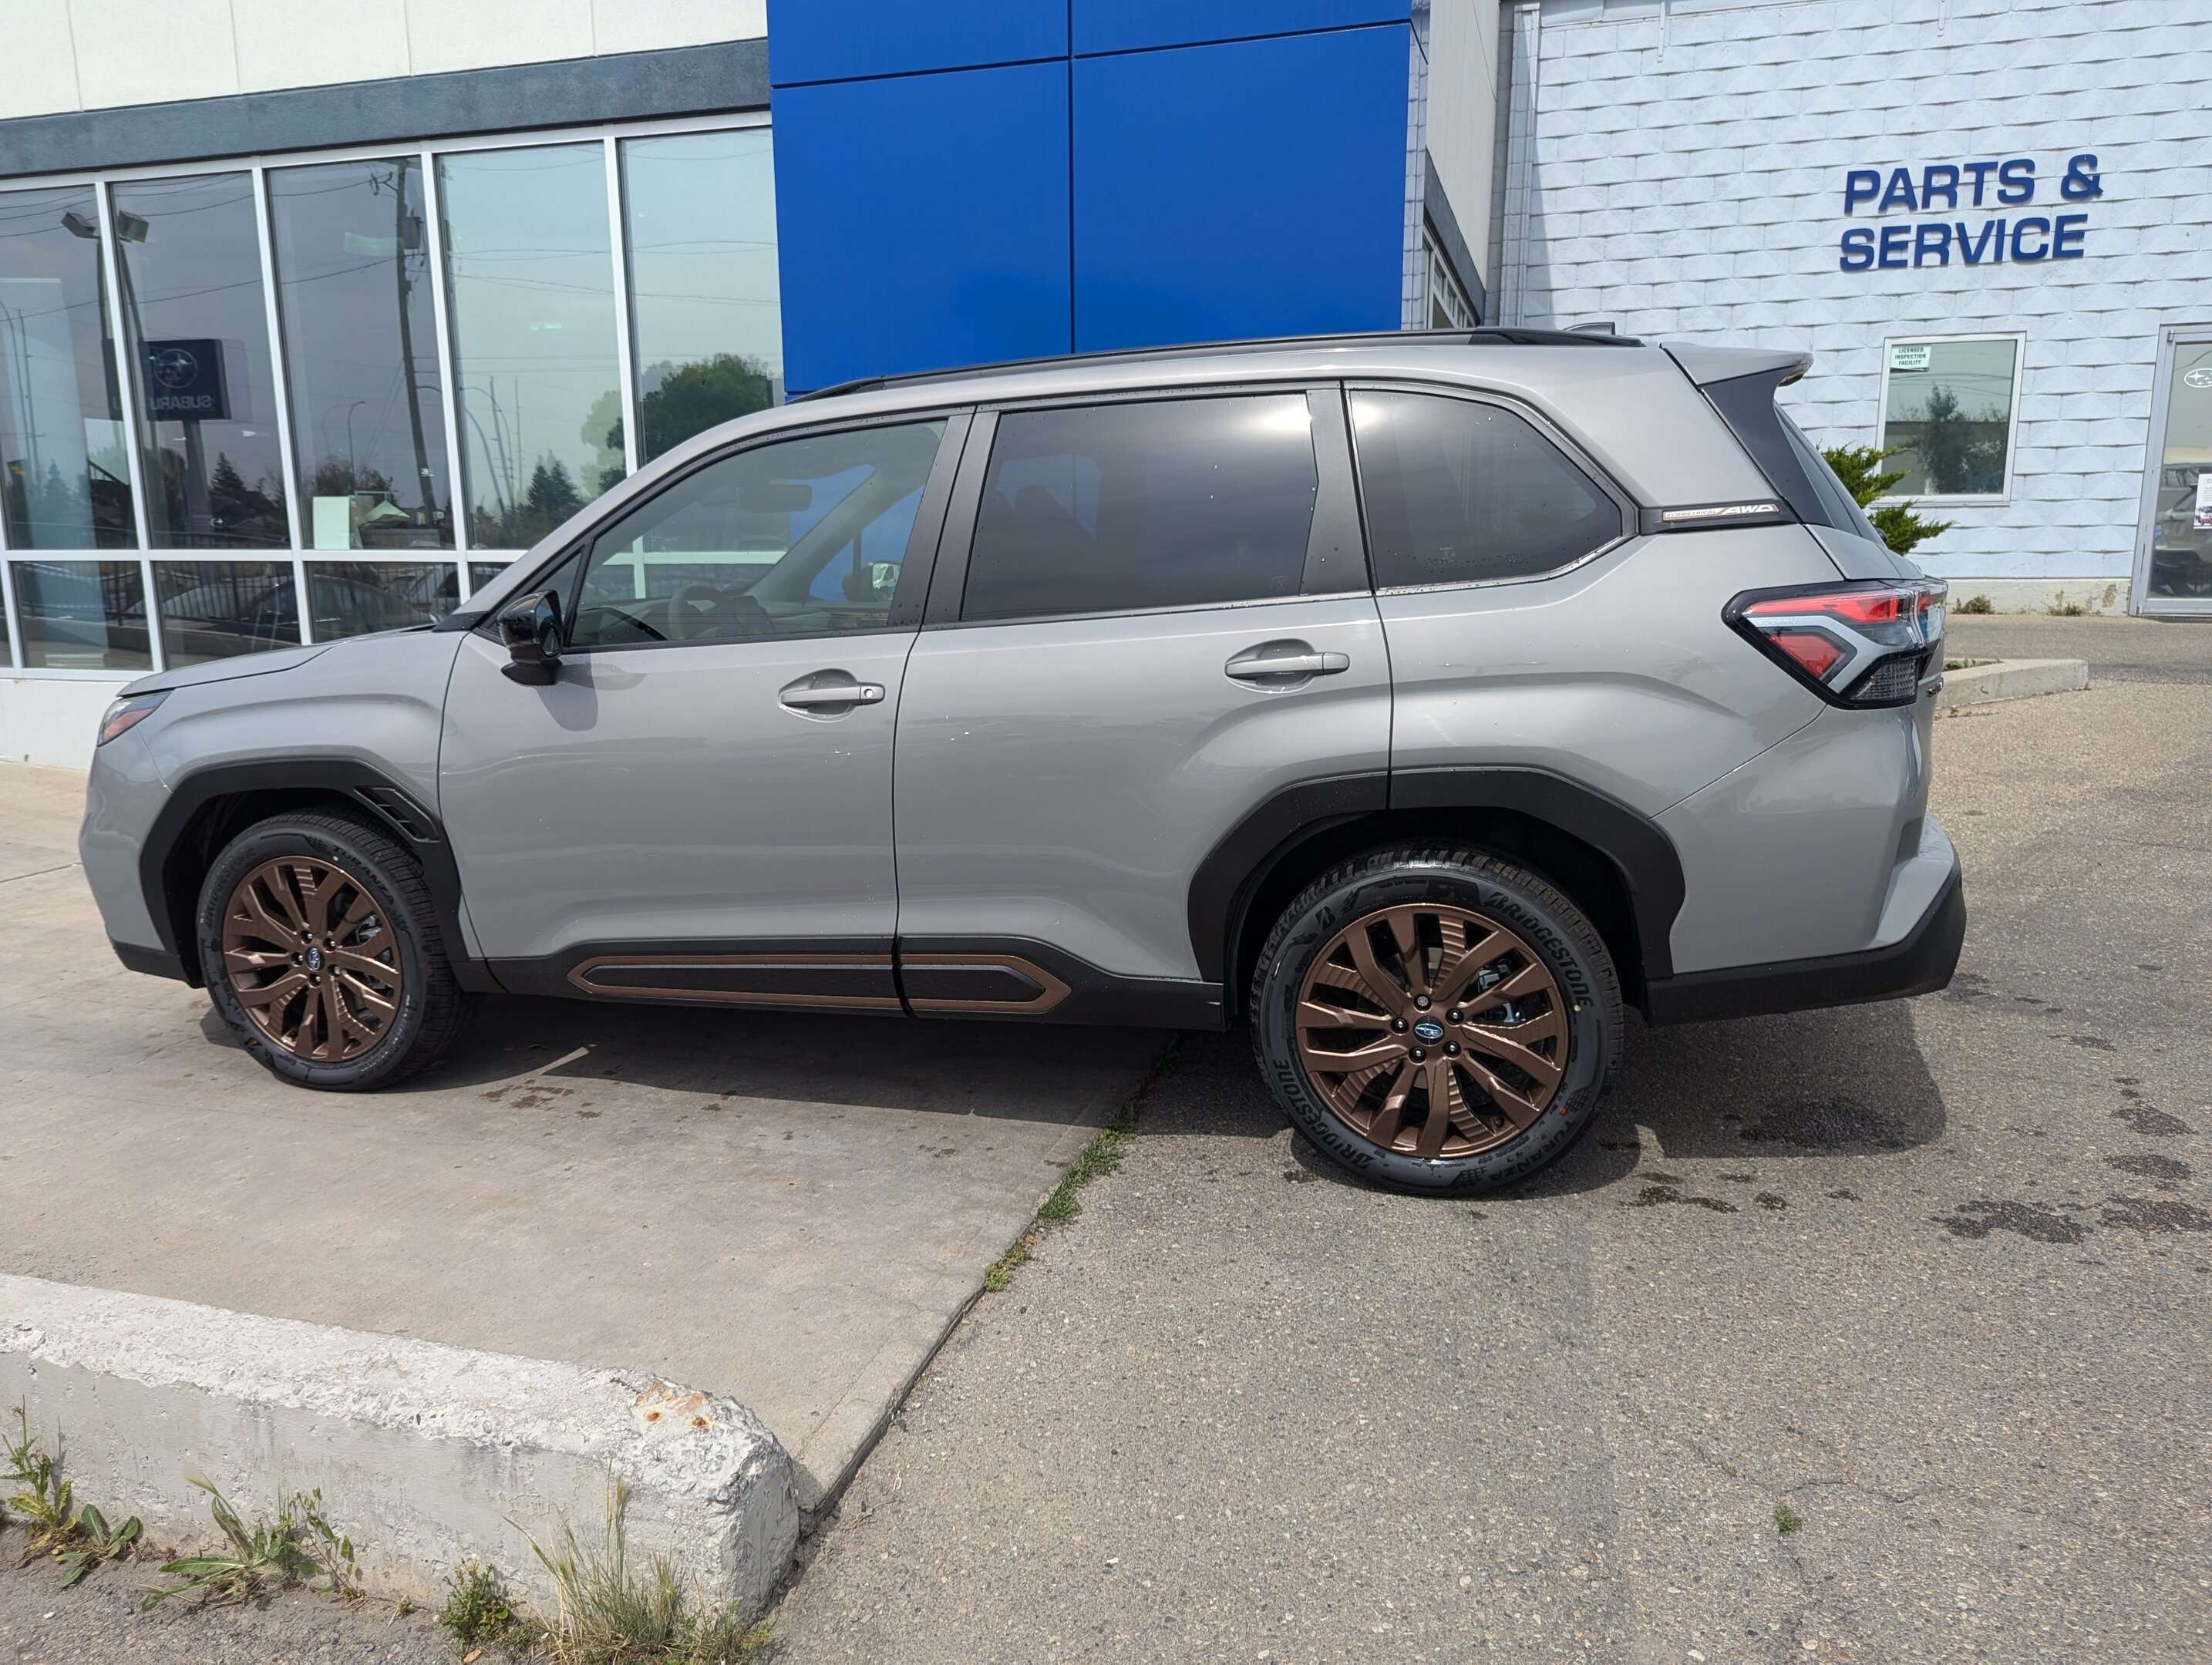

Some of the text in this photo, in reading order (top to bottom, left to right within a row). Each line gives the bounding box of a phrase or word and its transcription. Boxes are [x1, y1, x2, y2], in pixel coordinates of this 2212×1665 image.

[1844, 153, 2103, 217] PARTS &
[1840, 214, 2088, 272] SERVICE
[1722, 503, 1775, 515] AWD
[1483, 891, 1594, 1007] BRIDGESTONE
[1273, 1058, 1376, 1169] BRIDGESTONE
